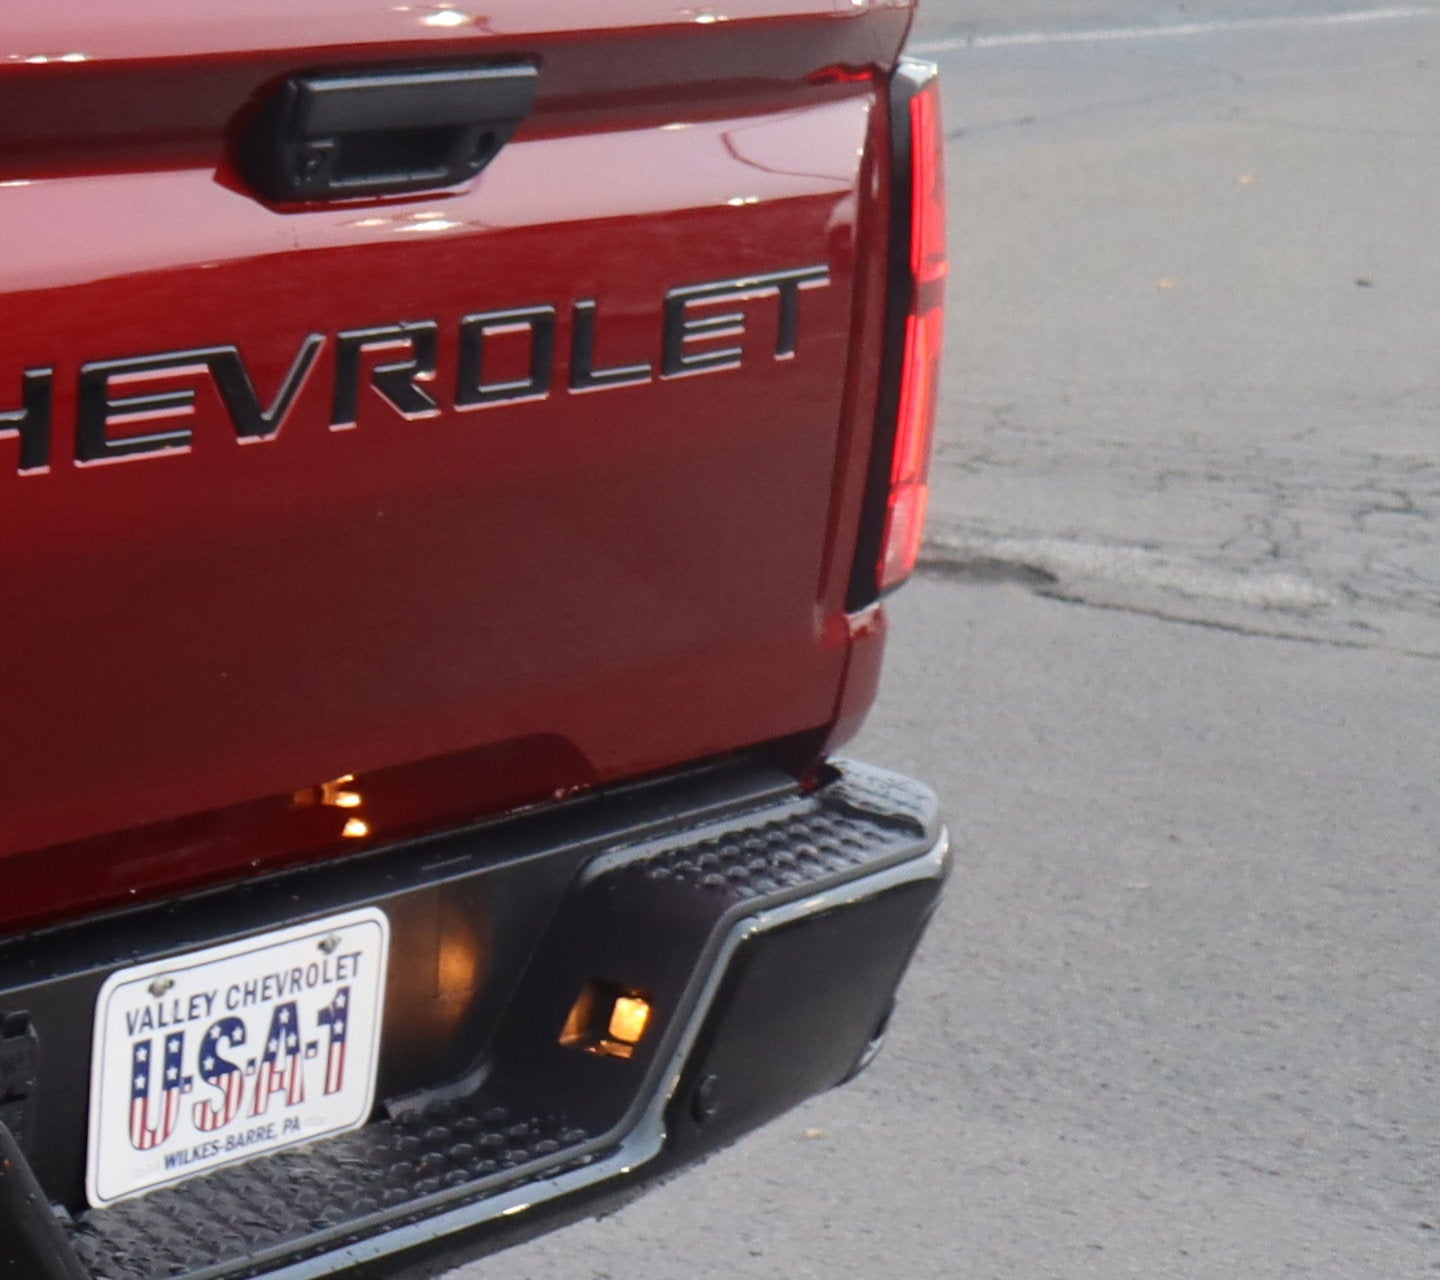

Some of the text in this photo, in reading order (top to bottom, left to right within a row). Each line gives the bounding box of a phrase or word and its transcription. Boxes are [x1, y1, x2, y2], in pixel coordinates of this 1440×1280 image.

[125, 952, 362, 1037] VALLEY CHEVROLET
[164, 1117, 301, 1170] WILKES-BARRE, PA
